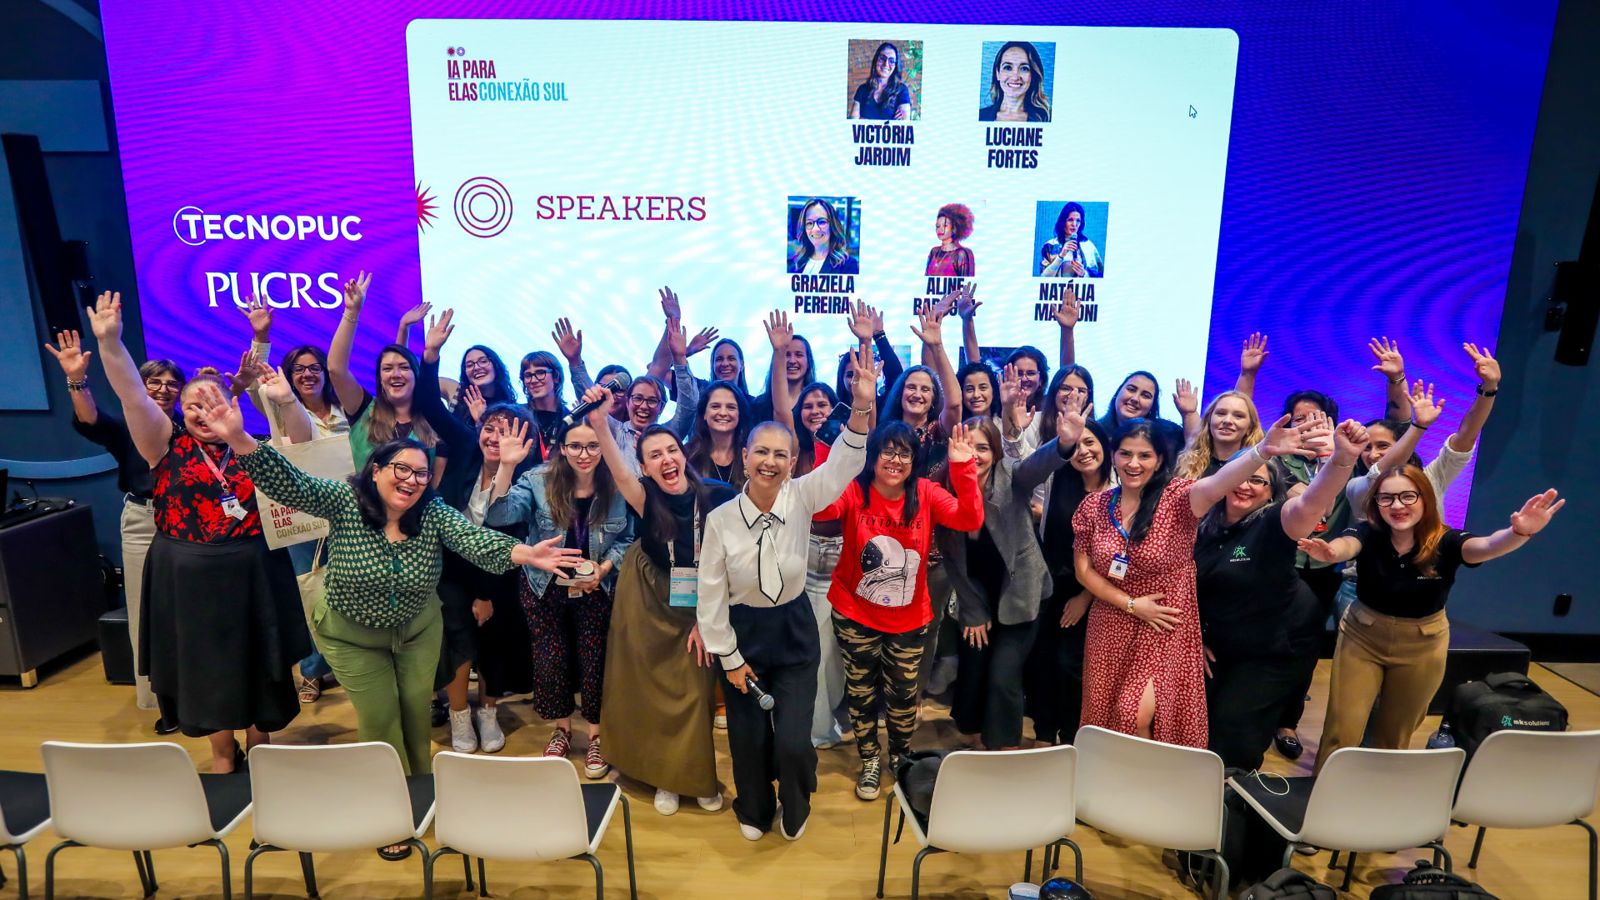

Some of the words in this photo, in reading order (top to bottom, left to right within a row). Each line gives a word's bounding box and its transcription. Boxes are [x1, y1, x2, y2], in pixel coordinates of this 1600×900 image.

[447, 60, 461, 79] IA
[463, 60, 497, 79] PARA
[448, 82, 478, 101] ELAS
[479, 78, 540, 101] CONEXÃO
[543, 82, 568, 101] SUL
[852, 121, 915, 145] VICTÓRIA
[985, 127, 1043, 147] LUCIANE
[854, 146, 911, 166] JARDIM
[987, 149, 1039, 169] FORTES
[536, 195, 707, 221] SPEAKERS
[181, 214, 363, 241] TECNOPUC
[205, 272, 343, 309] PUCRS
[791, 274, 855, 293] GRAZIELA
[794, 295, 850, 314] PEREIRA
[273, 517, 293, 529] ELAS
[276, 522, 311, 538] CONEXÃO
[312, 519, 327, 530] SUL
